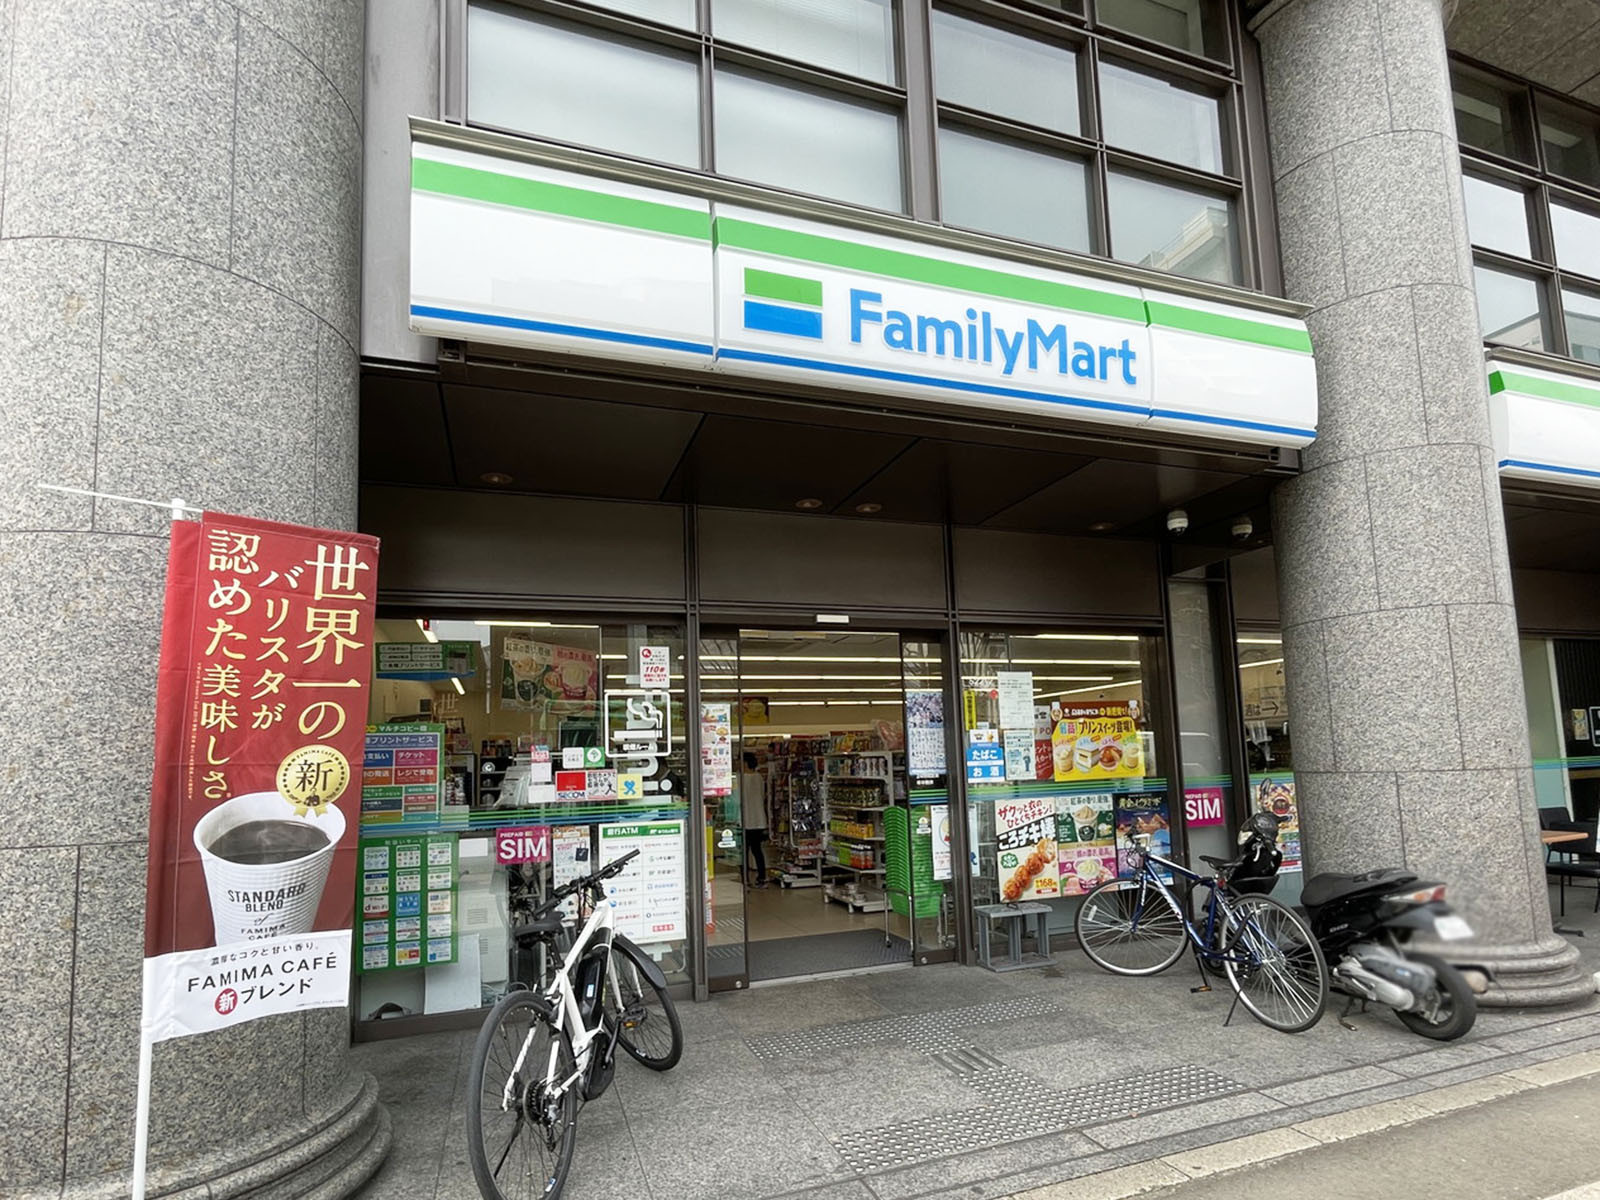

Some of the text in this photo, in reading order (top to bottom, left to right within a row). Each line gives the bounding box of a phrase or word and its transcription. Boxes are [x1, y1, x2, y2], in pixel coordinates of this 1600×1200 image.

[850, 287, 1138, 385] FamilyMart
[250, 572, 302, 731] バリスタが
[292, 542, 371, 745] 世界一の
[199, 529, 262, 801] 認めた美味しさ
[971, 749, 999, 761] たばこ
[295, 759, 334, 793] 新
[1186, 799, 1221, 821] SIM
[499, 837, 547, 860] SIM
[227, 881, 307, 904] STANDARD
[244, 899, 285, 913] BLEND
[240, 922, 288, 936] FAMIMA
[211, 941, 319, 967] 濃厚なコクと甘い香り。
[187, 950, 338, 993] FAMIMA CAFÉ
[240, 976, 314, 1005] ブレンド
